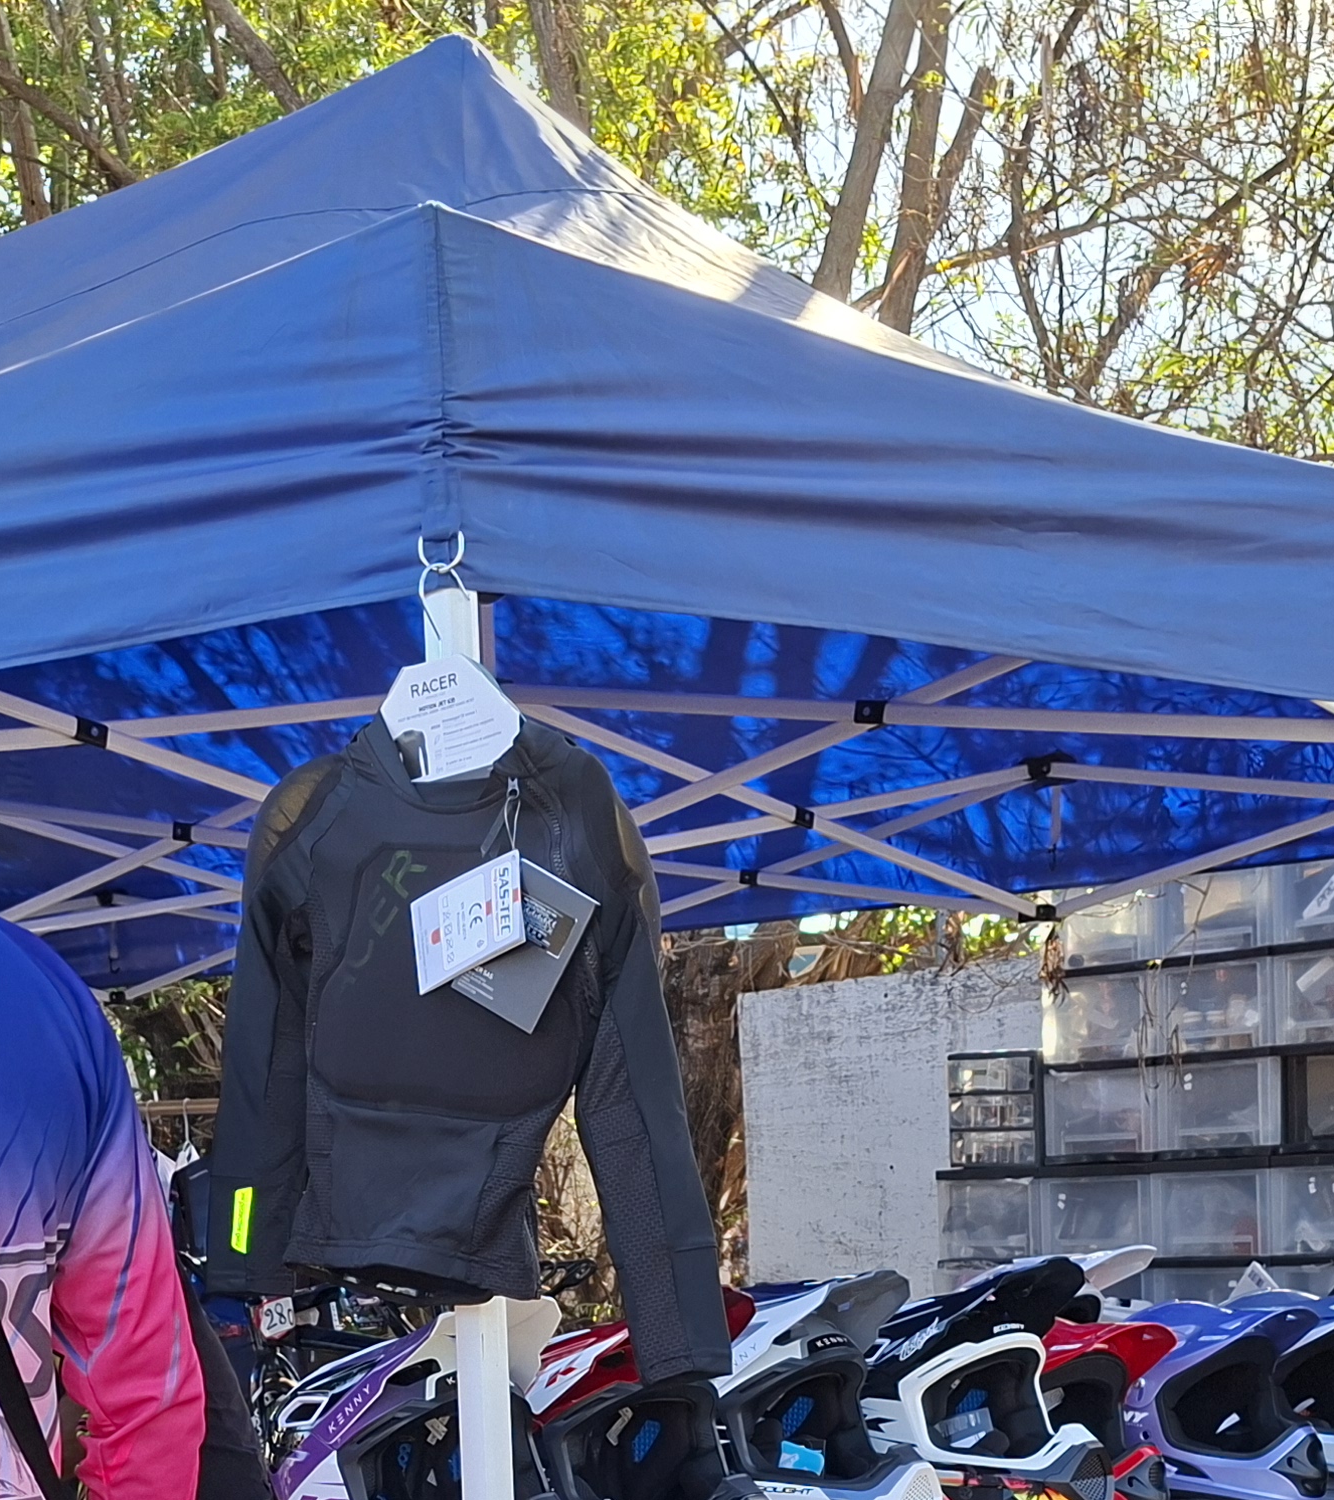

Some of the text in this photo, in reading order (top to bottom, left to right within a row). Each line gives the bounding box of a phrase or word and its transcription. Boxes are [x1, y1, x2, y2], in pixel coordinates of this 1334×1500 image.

[410, 672, 459, 699] RACER
[498, 867, 512, 936] SAS-TEC
[328, 1383, 372, 1433] KENNY
